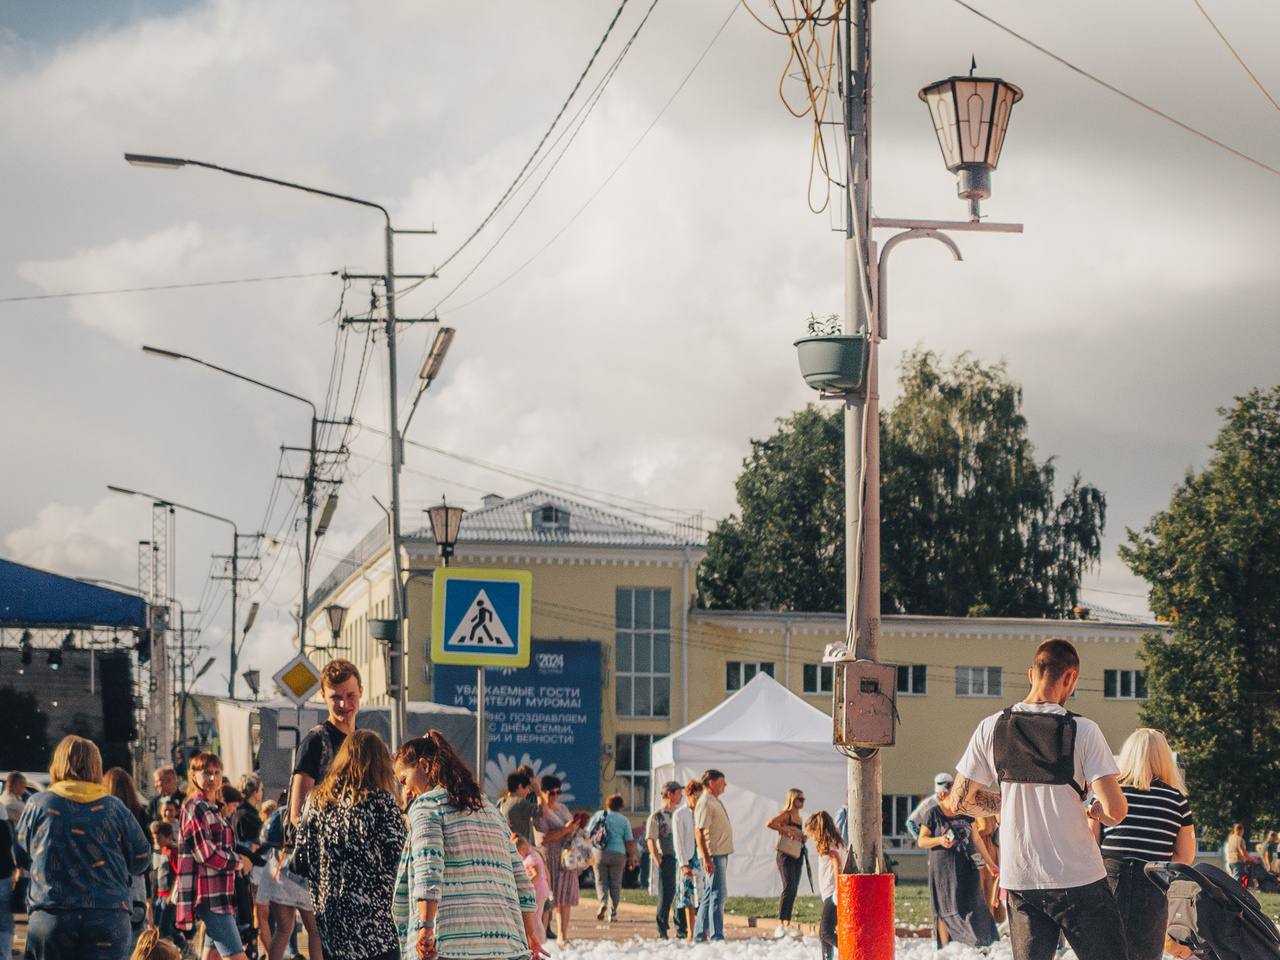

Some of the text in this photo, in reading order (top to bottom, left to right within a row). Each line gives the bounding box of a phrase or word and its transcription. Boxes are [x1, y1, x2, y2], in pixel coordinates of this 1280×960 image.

[539, 654, 564, 668] 2024
[540, 686, 580, 697] ГОСТИ
[454, 696, 463, 705] И
[525, 698, 581, 708] МУРОМА!
[510, 712, 587, 724] ПОЗДРАВЛЯЕМ
[489, 722, 574, 734] С ДНЁМ СЕМЬИ,
[505, 734, 512, 742] И
[516, 734, 574, 744] ВЕРНОСТИ!
